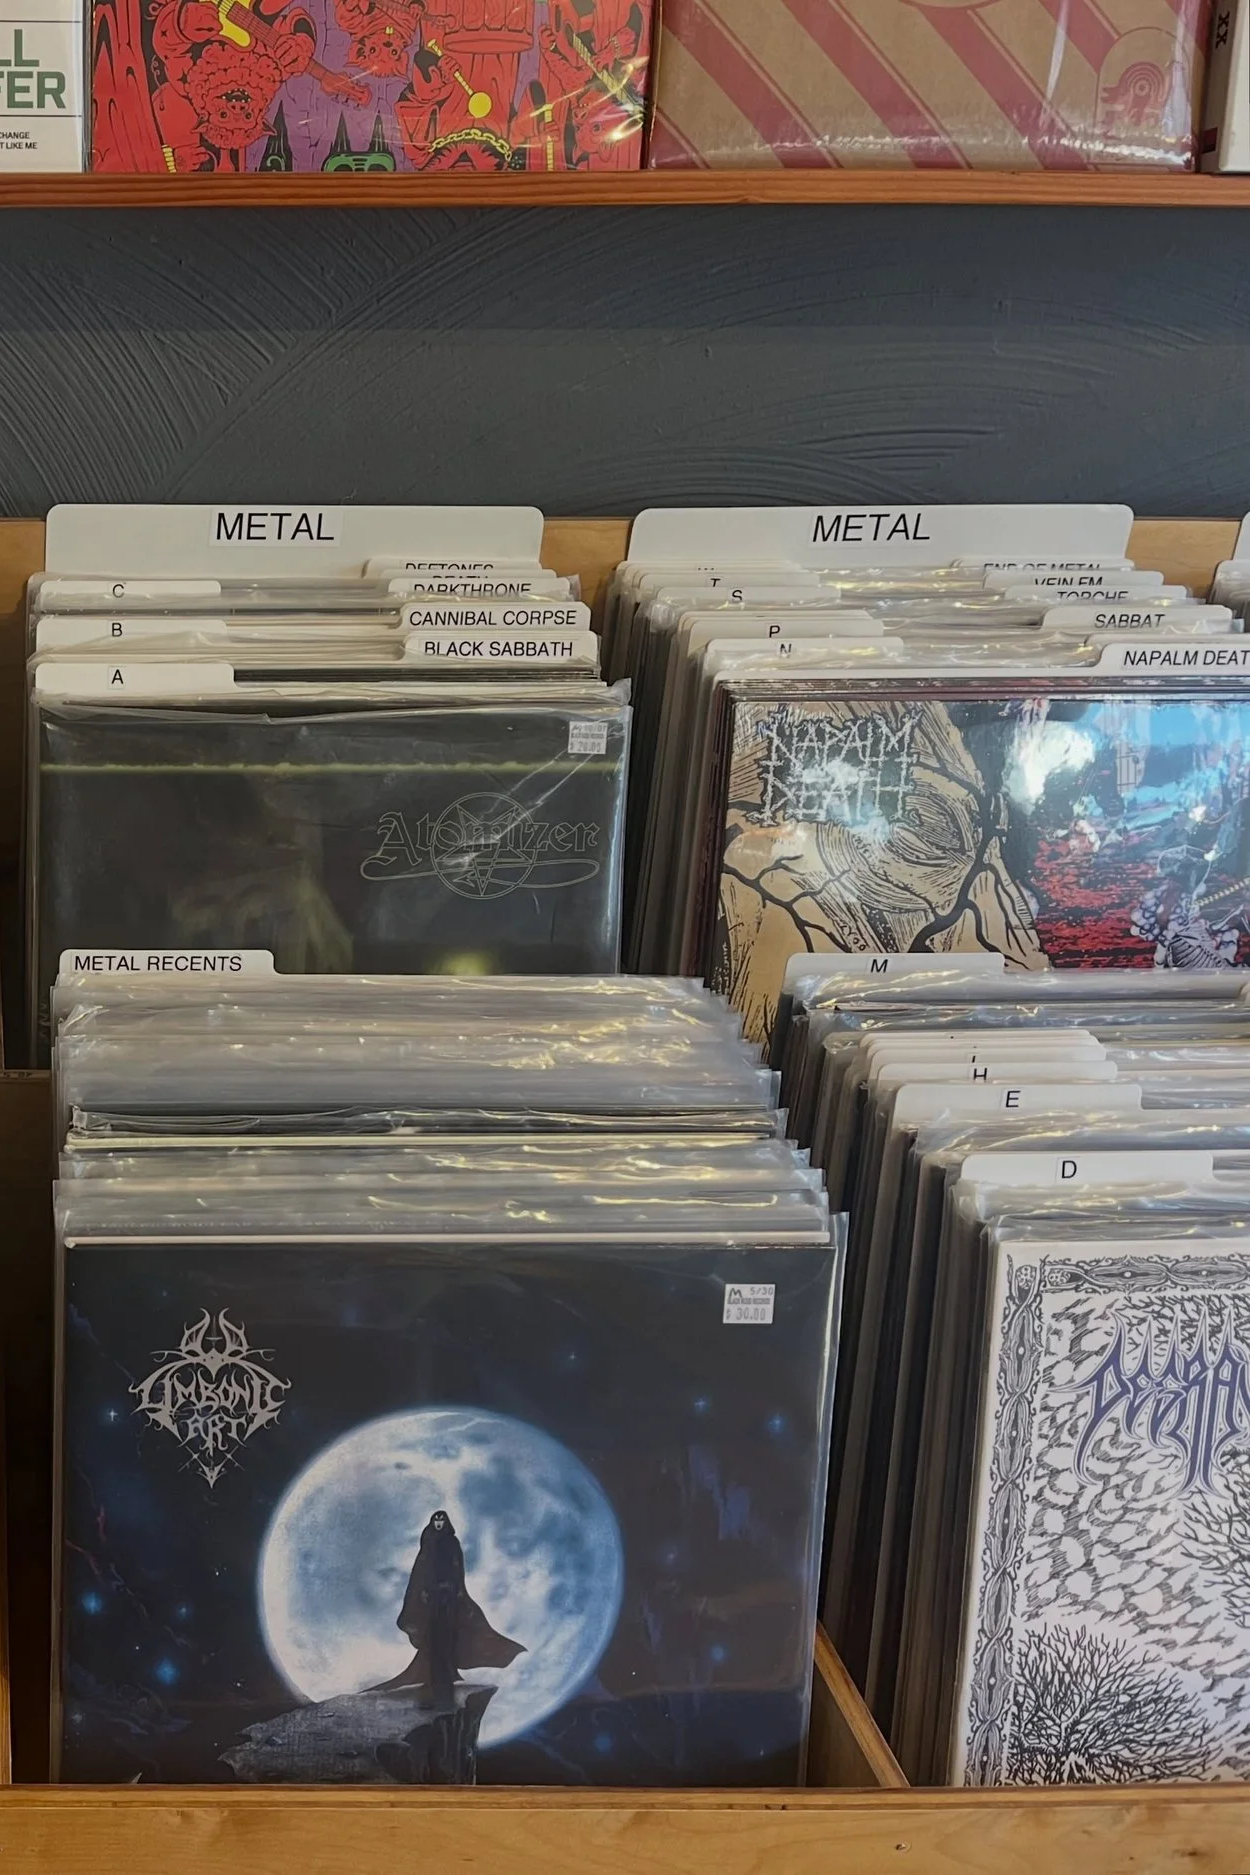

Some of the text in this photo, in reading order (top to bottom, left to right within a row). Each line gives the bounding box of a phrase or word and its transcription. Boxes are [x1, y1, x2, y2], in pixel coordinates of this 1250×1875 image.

[216, 513, 335, 541] METAL
[812, 512, 931, 543] METAL
[112, 583, 126, 599] C
[710, 578, 721, 588] T
[409, 610, 578, 626] CANNIBAL CORPSE
[1094, 613, 1166, 629] SABBAT
[112, 622, 124, 638] B
[769, 625, 781, 638] P
[424, 641, 573, 657] BLACK SABBATH
[1123, 650, 1199, 666] NAPALM
[111, 669, 125, 685] A
[74, 954, 243, 973] METAL RECENTS
[870, 958, 889, 974] M
[1005, 1091, 1021, 1108] E
[1061, 1160, 1078, 1179] D
[735, 1307, 767, 1321] 30.00
[178, 1410, 246, 1457] ART
